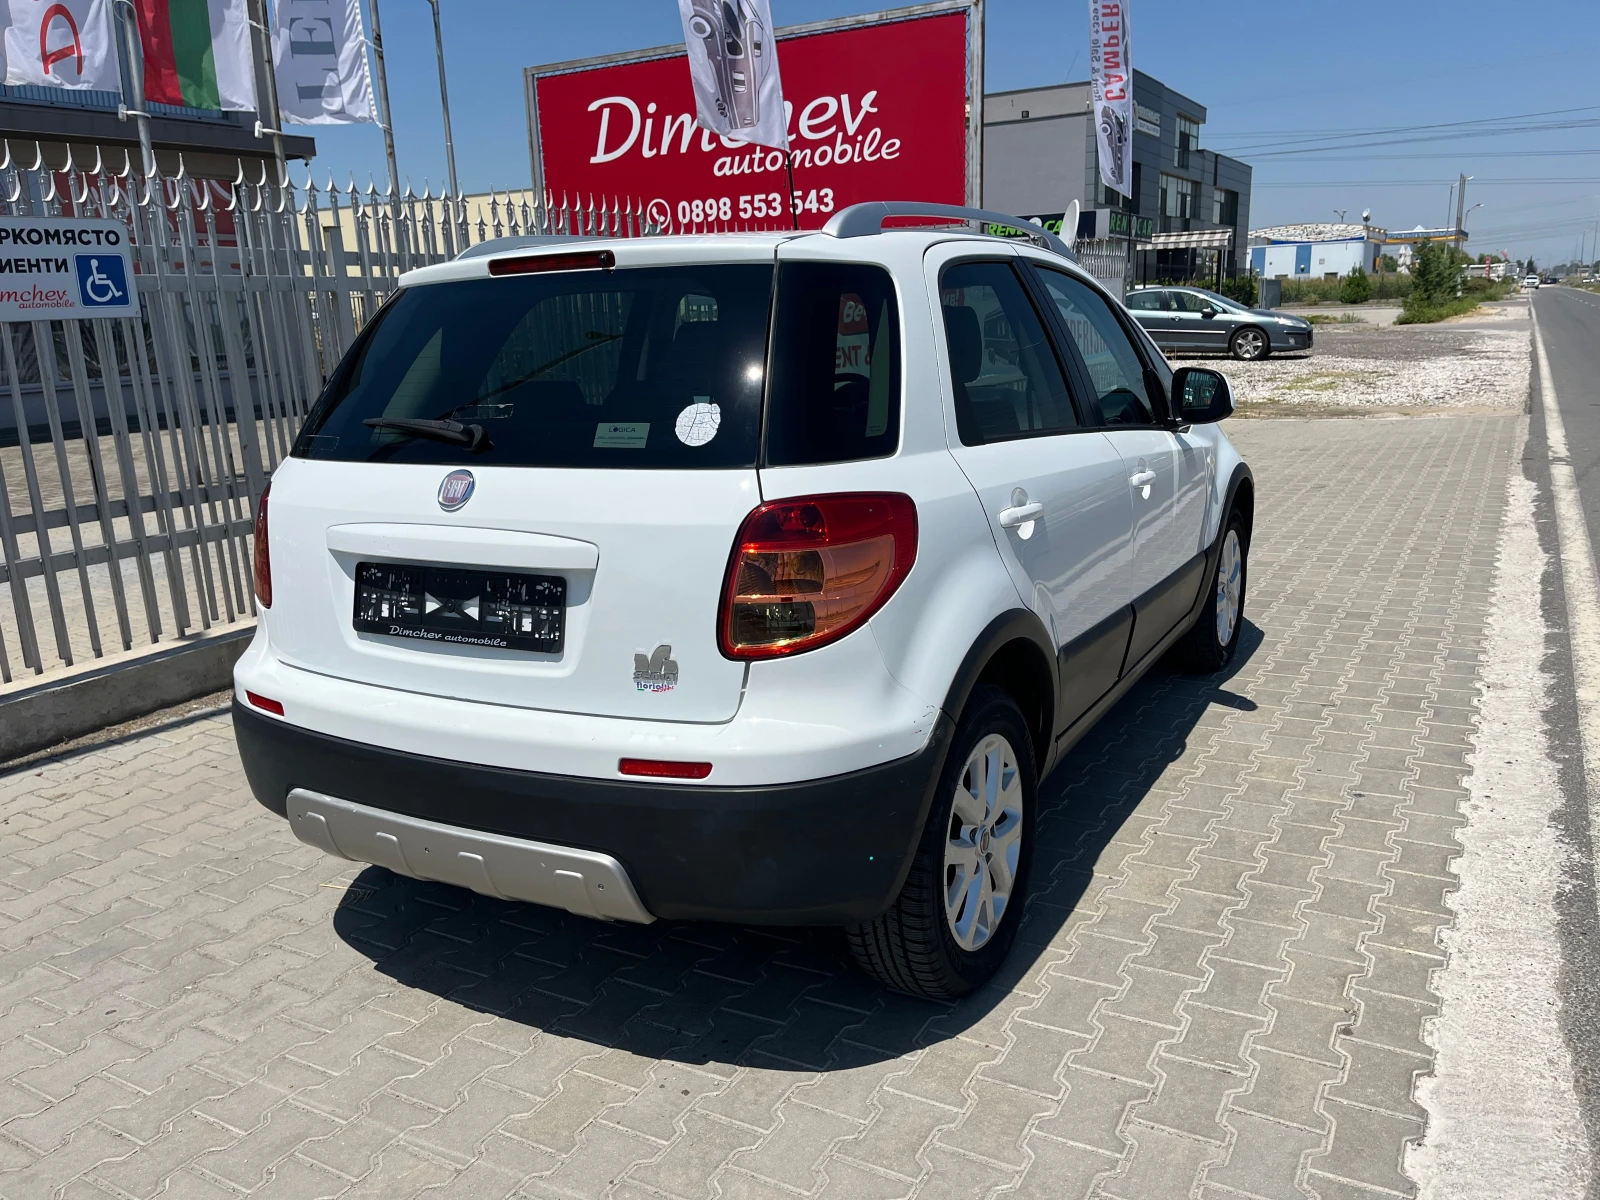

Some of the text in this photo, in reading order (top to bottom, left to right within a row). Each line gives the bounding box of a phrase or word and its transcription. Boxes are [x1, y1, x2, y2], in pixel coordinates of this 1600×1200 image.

[713, 127, 901, 177] automobile
[677, 188, 834, 224] 0898 553 543
[1137, 218, 1153, 235] CAR
[0, 228, 120, 246] РКОМЯСТО
[19, 300, 75, 309] automobile
[389, 625, 507, 647] Dimchev automobile
